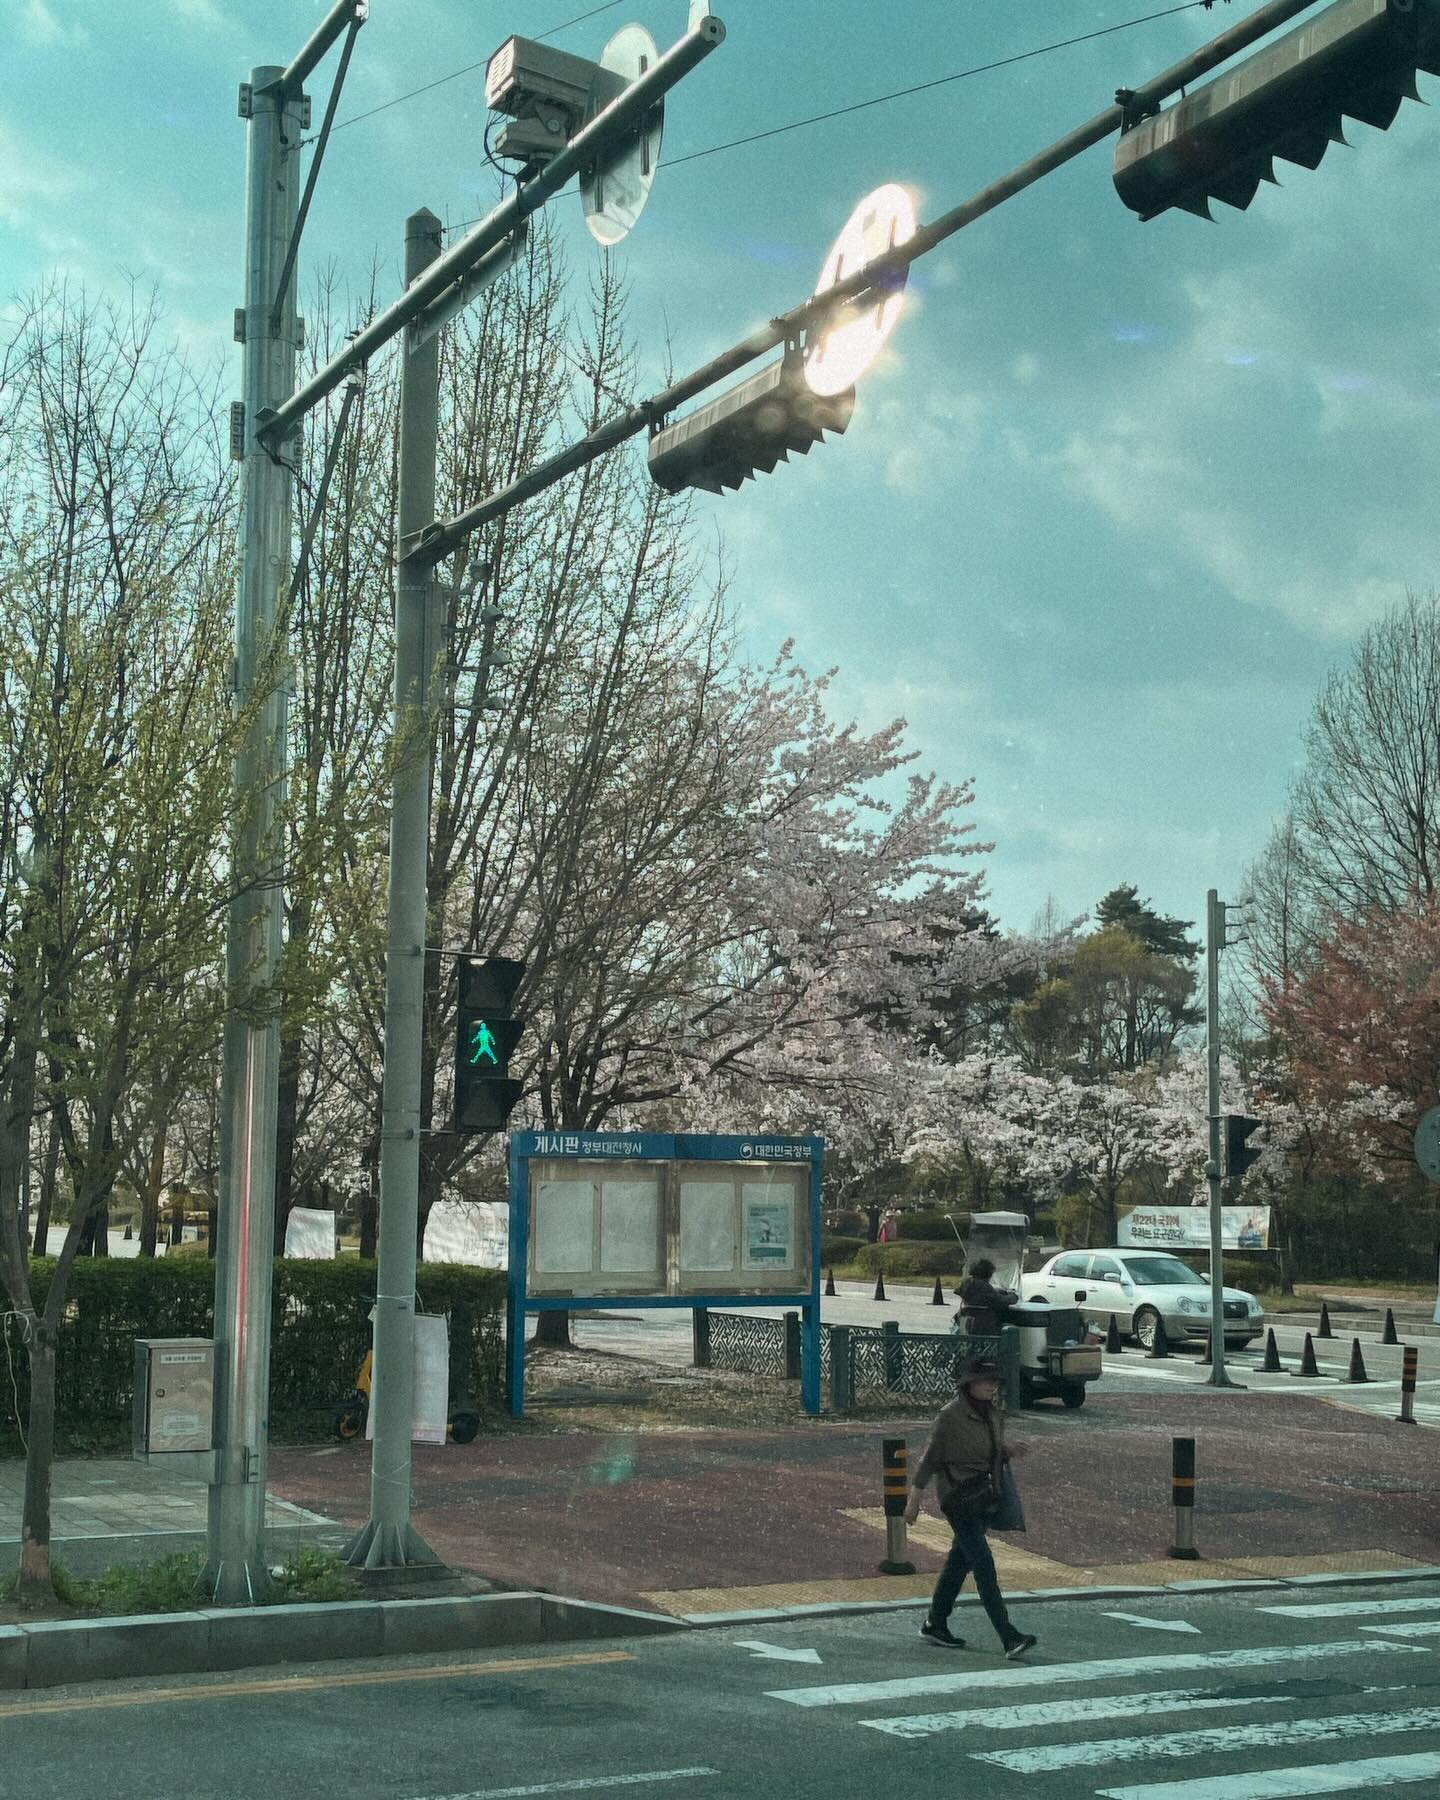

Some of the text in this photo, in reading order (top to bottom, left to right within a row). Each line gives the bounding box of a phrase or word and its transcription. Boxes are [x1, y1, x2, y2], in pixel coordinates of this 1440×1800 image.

[534, 1136, 642, 1154] 게시판 정부대전청사
[755, 1144, 812, 1158] 대한민국정부
